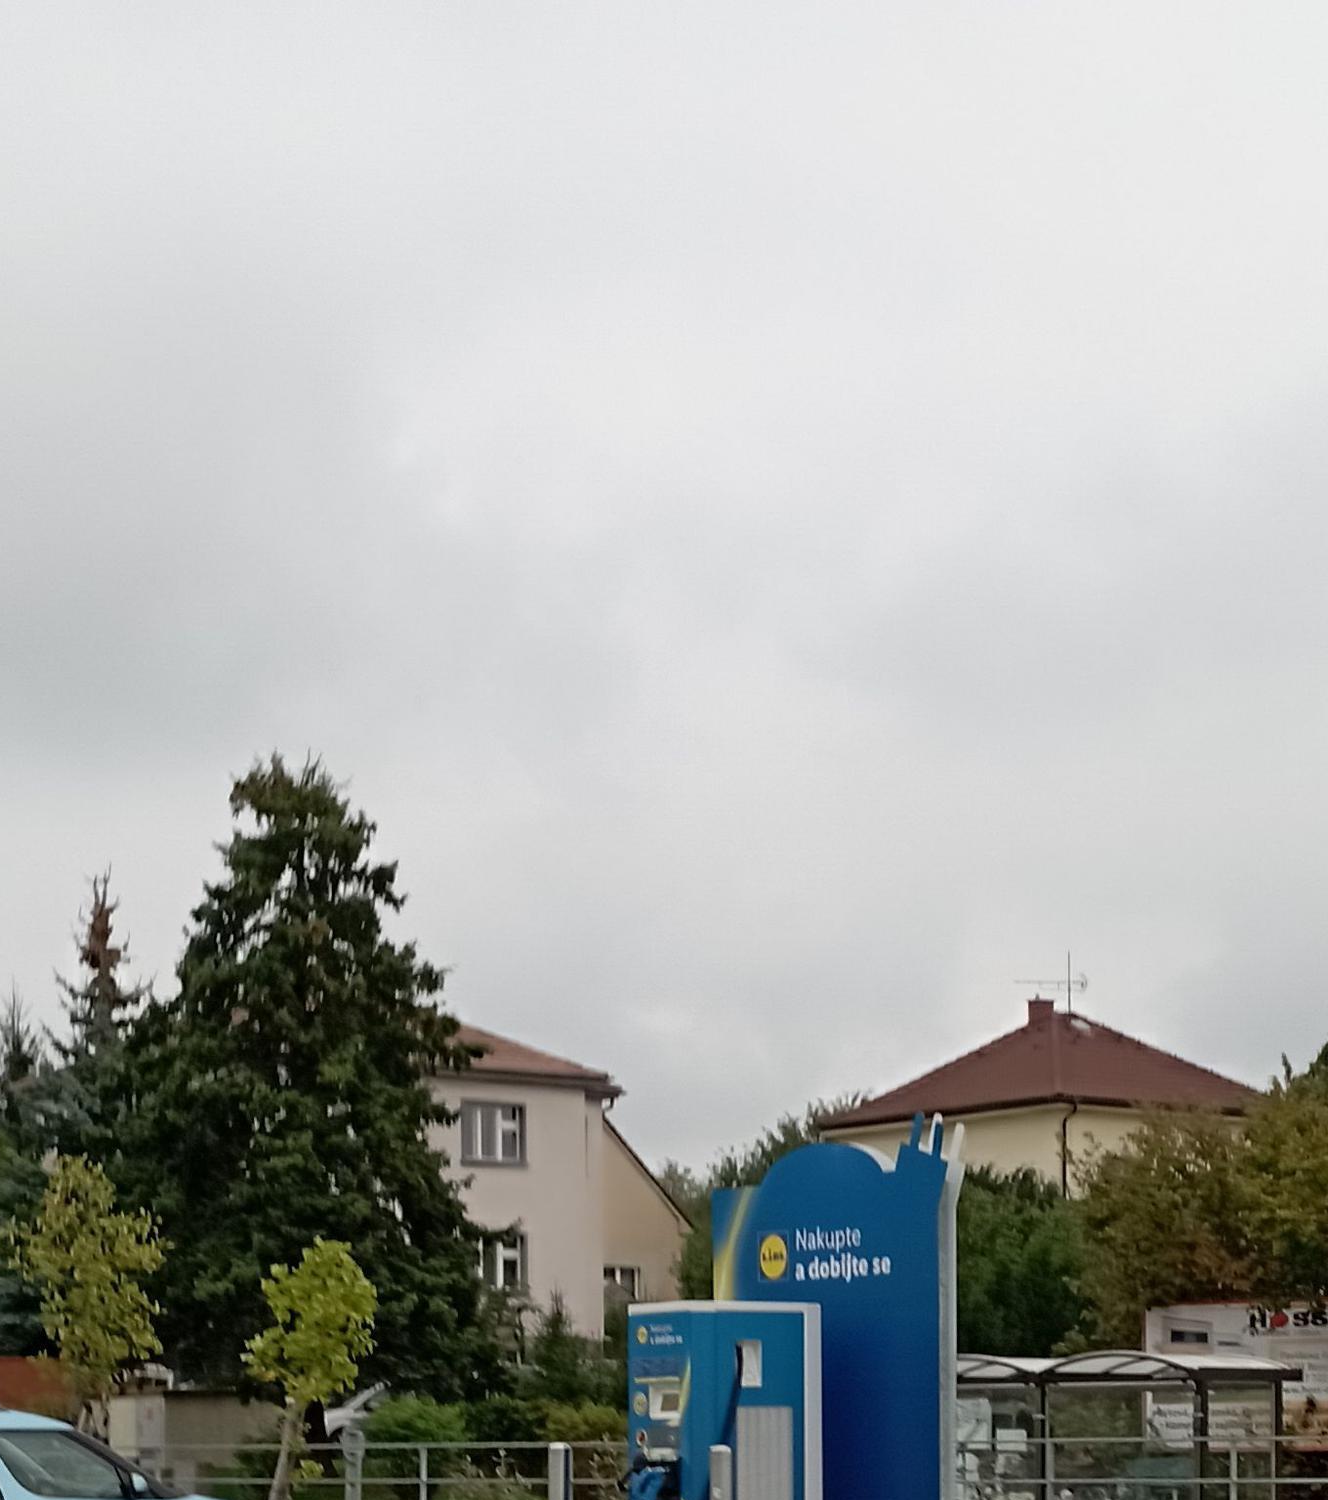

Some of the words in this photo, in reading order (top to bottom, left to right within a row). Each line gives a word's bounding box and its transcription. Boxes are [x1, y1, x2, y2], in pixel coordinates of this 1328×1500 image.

[795, 1226, 861, 1253] Nakupte
[795, 1262, 805, 1281] a
[808, 1252, 869, 1283] dobijte
[873, 1255, 891, 1276] se
